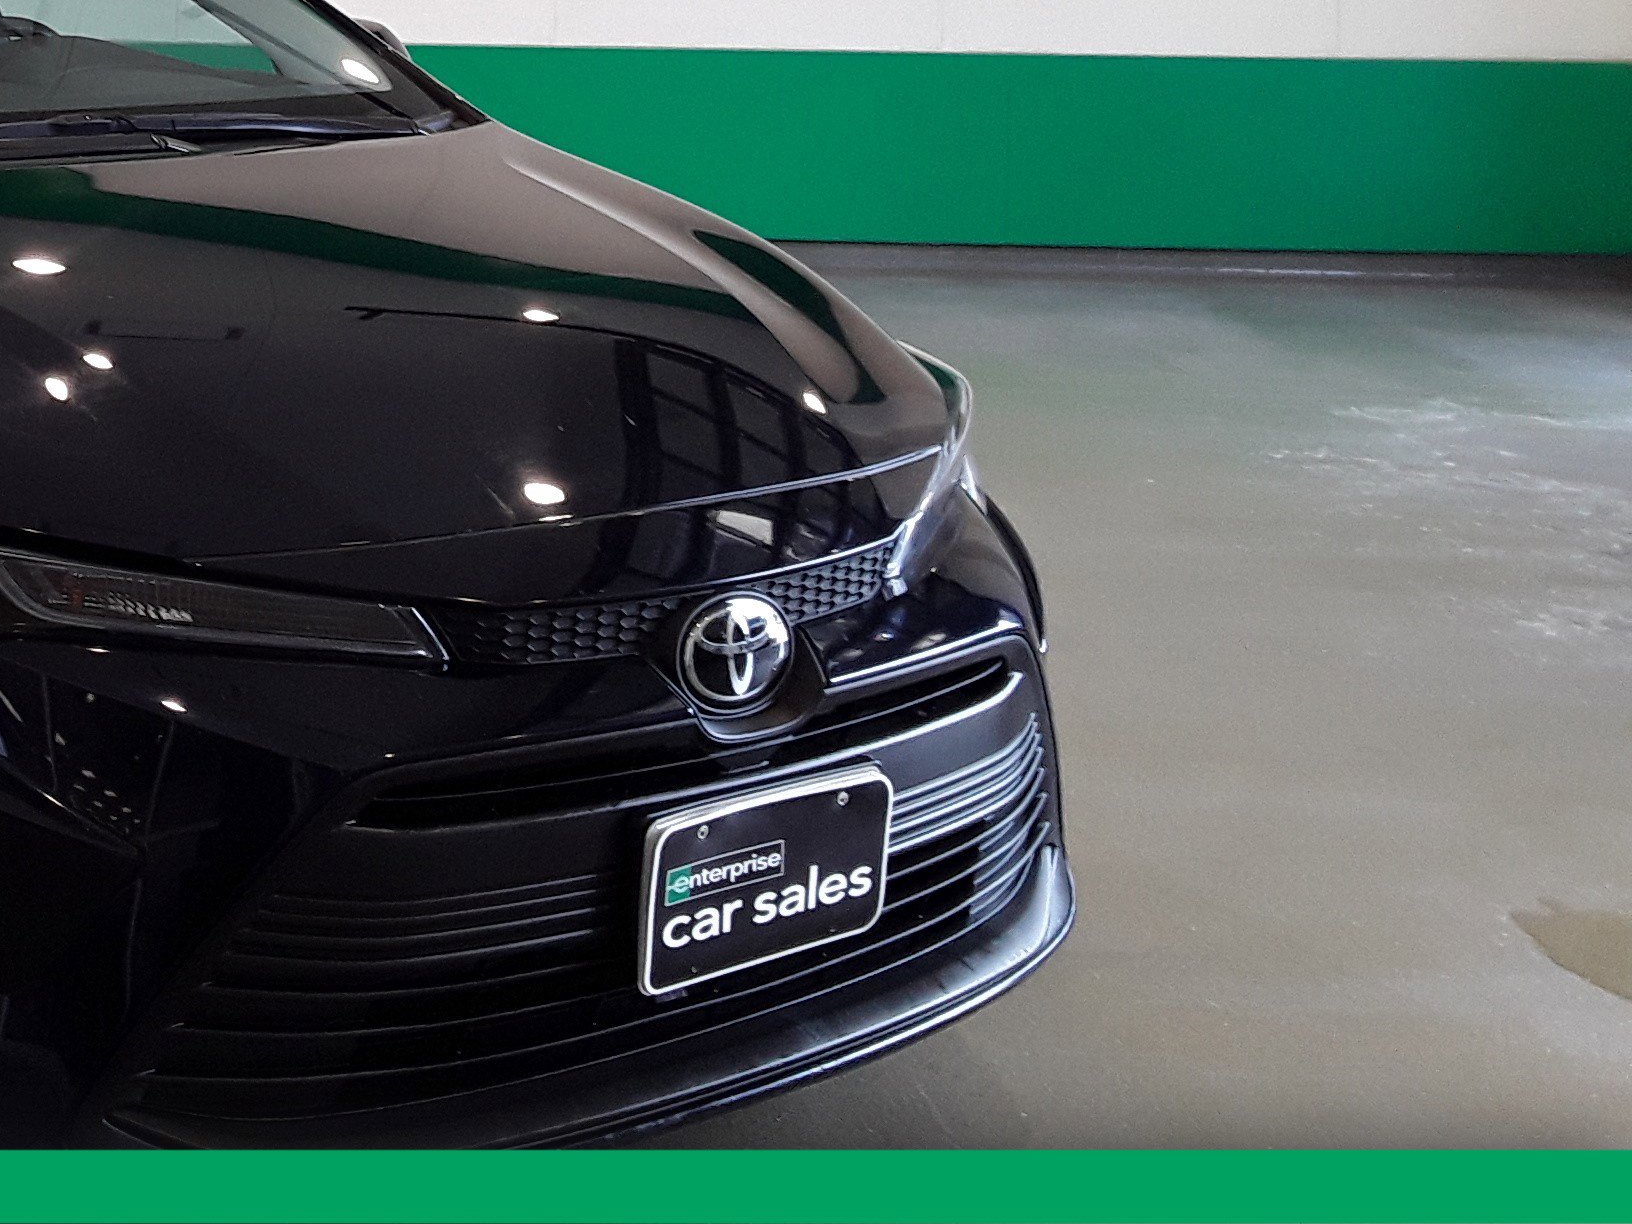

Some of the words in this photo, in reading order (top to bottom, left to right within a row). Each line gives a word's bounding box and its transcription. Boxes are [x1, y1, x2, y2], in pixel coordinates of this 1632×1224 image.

[668, 851, 782, 894] enterprise
[662, 898, 744, 949] car
[752, 863, 874, 925] sales
